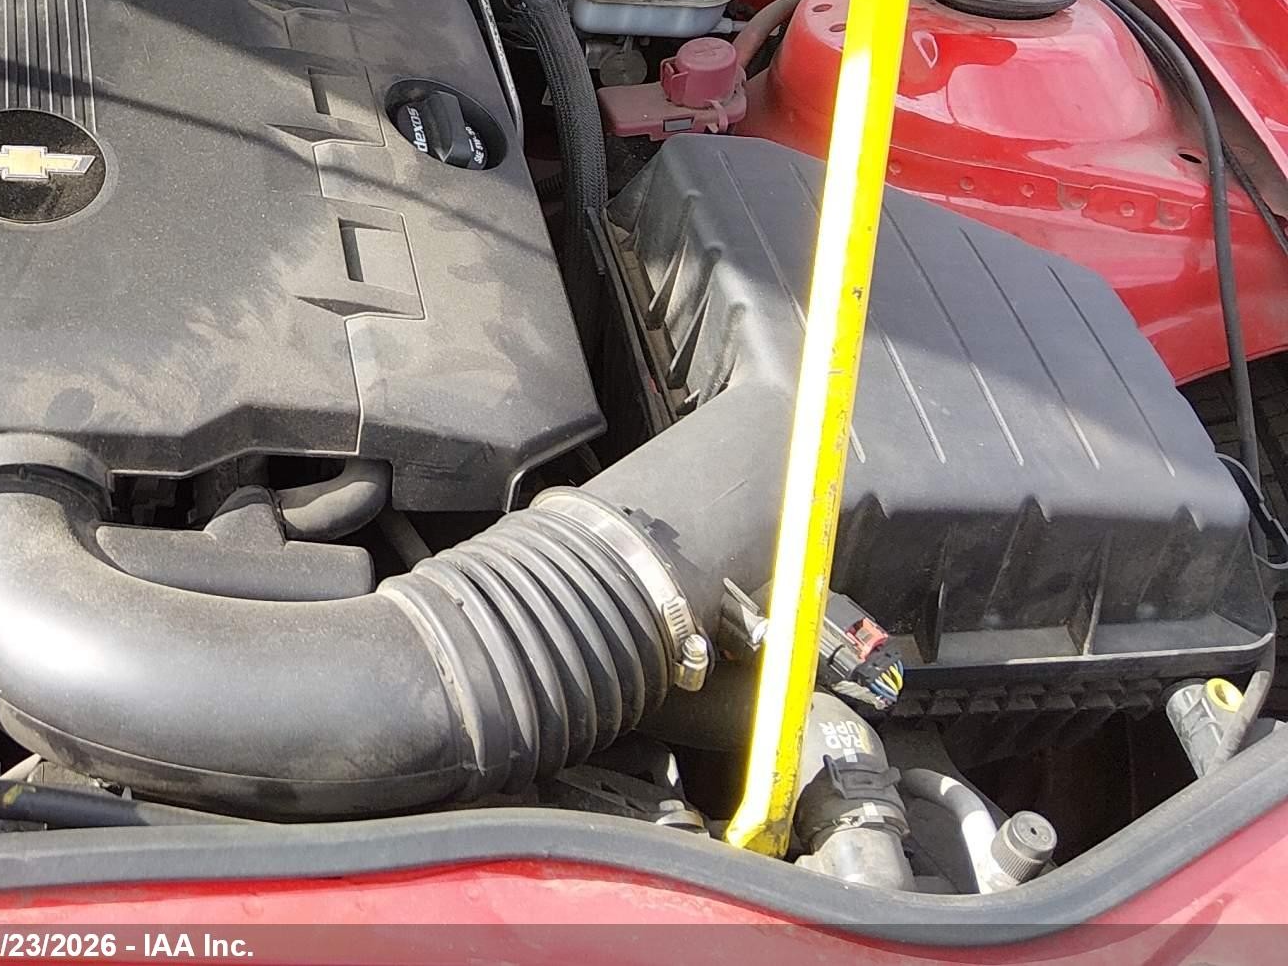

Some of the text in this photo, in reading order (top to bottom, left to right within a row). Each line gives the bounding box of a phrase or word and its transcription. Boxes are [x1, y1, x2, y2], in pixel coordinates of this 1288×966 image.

[406, 104, 429, 153] dexos
[473, 150, 485, 164] SAE
[818, 720, 859, 736] UPR
[825, 734, 863, 749] RAD
